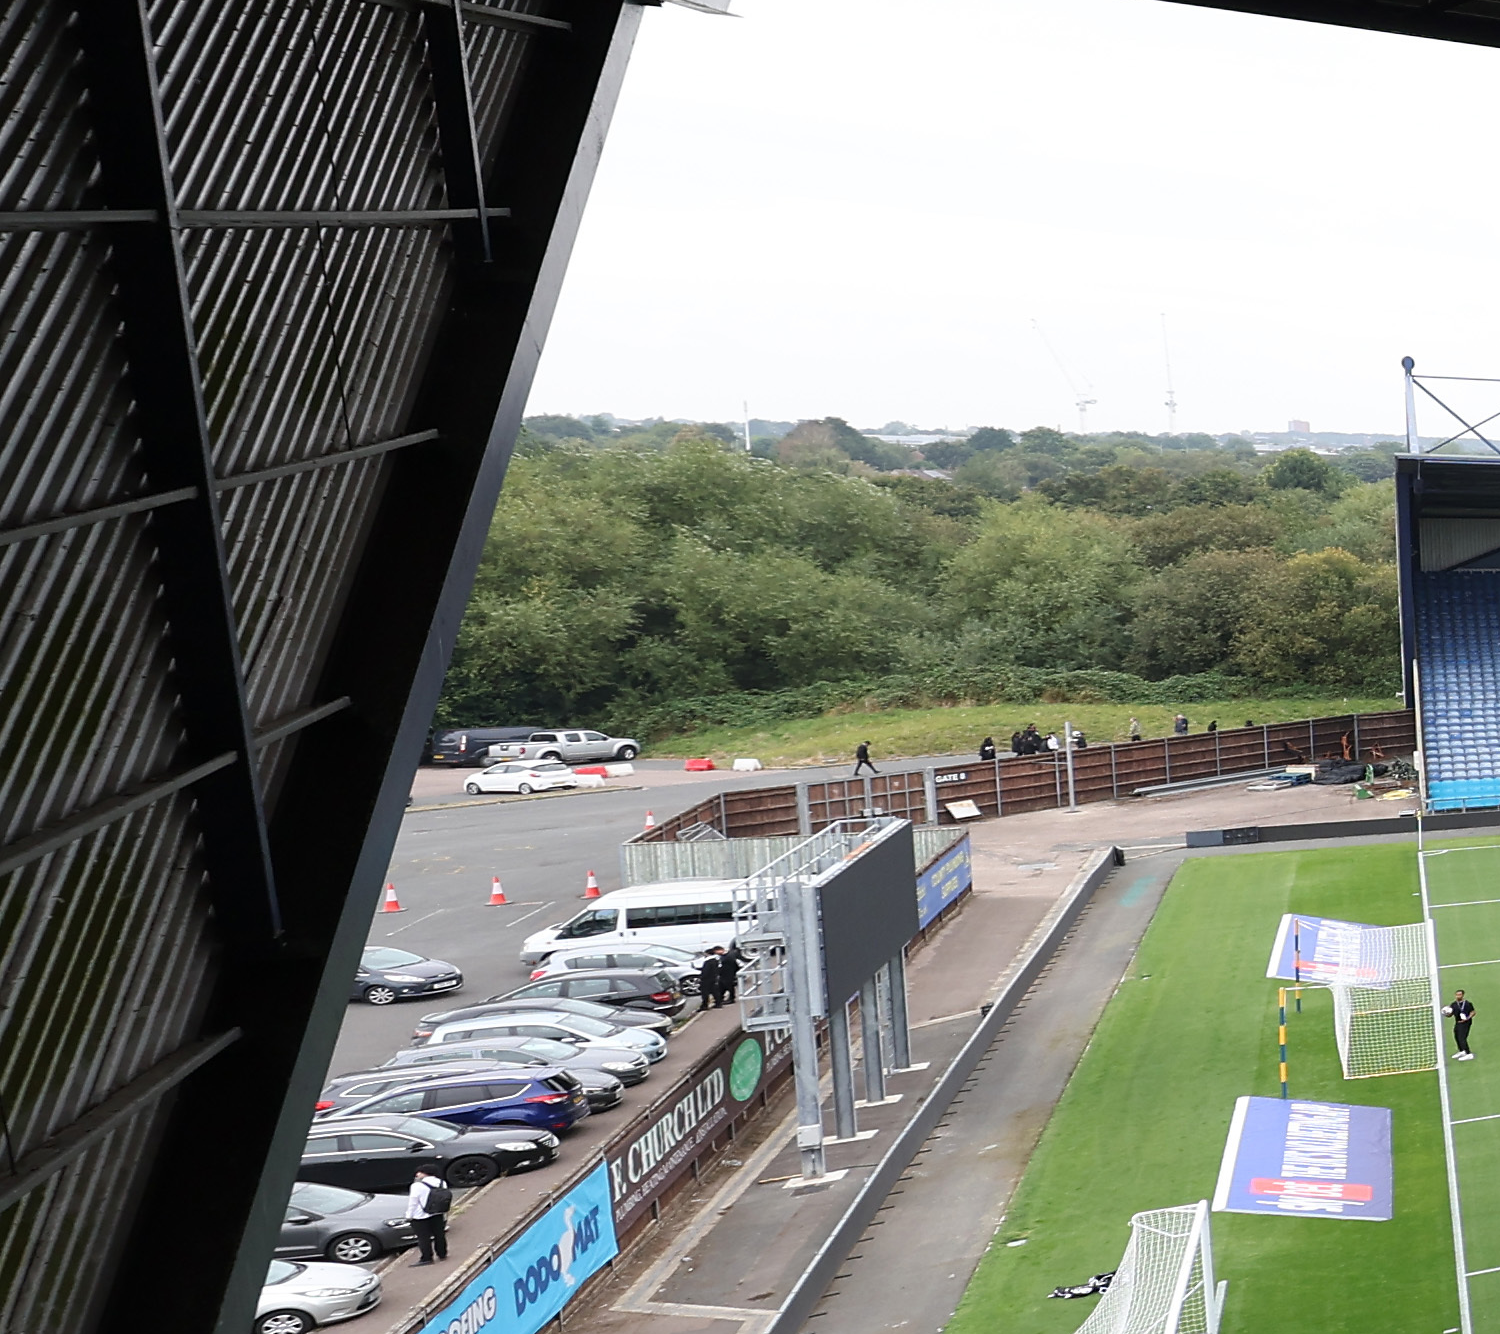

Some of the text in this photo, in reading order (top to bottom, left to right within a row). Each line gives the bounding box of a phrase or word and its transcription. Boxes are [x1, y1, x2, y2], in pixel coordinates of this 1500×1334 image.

[935, 773, 958, 783] GATE
[610, 1067, 725, 1201] F. CHURCH LTD
[1263, 1181, 1344, 1197] bet
[513, 1205, 600, 1317] DODO MAT
